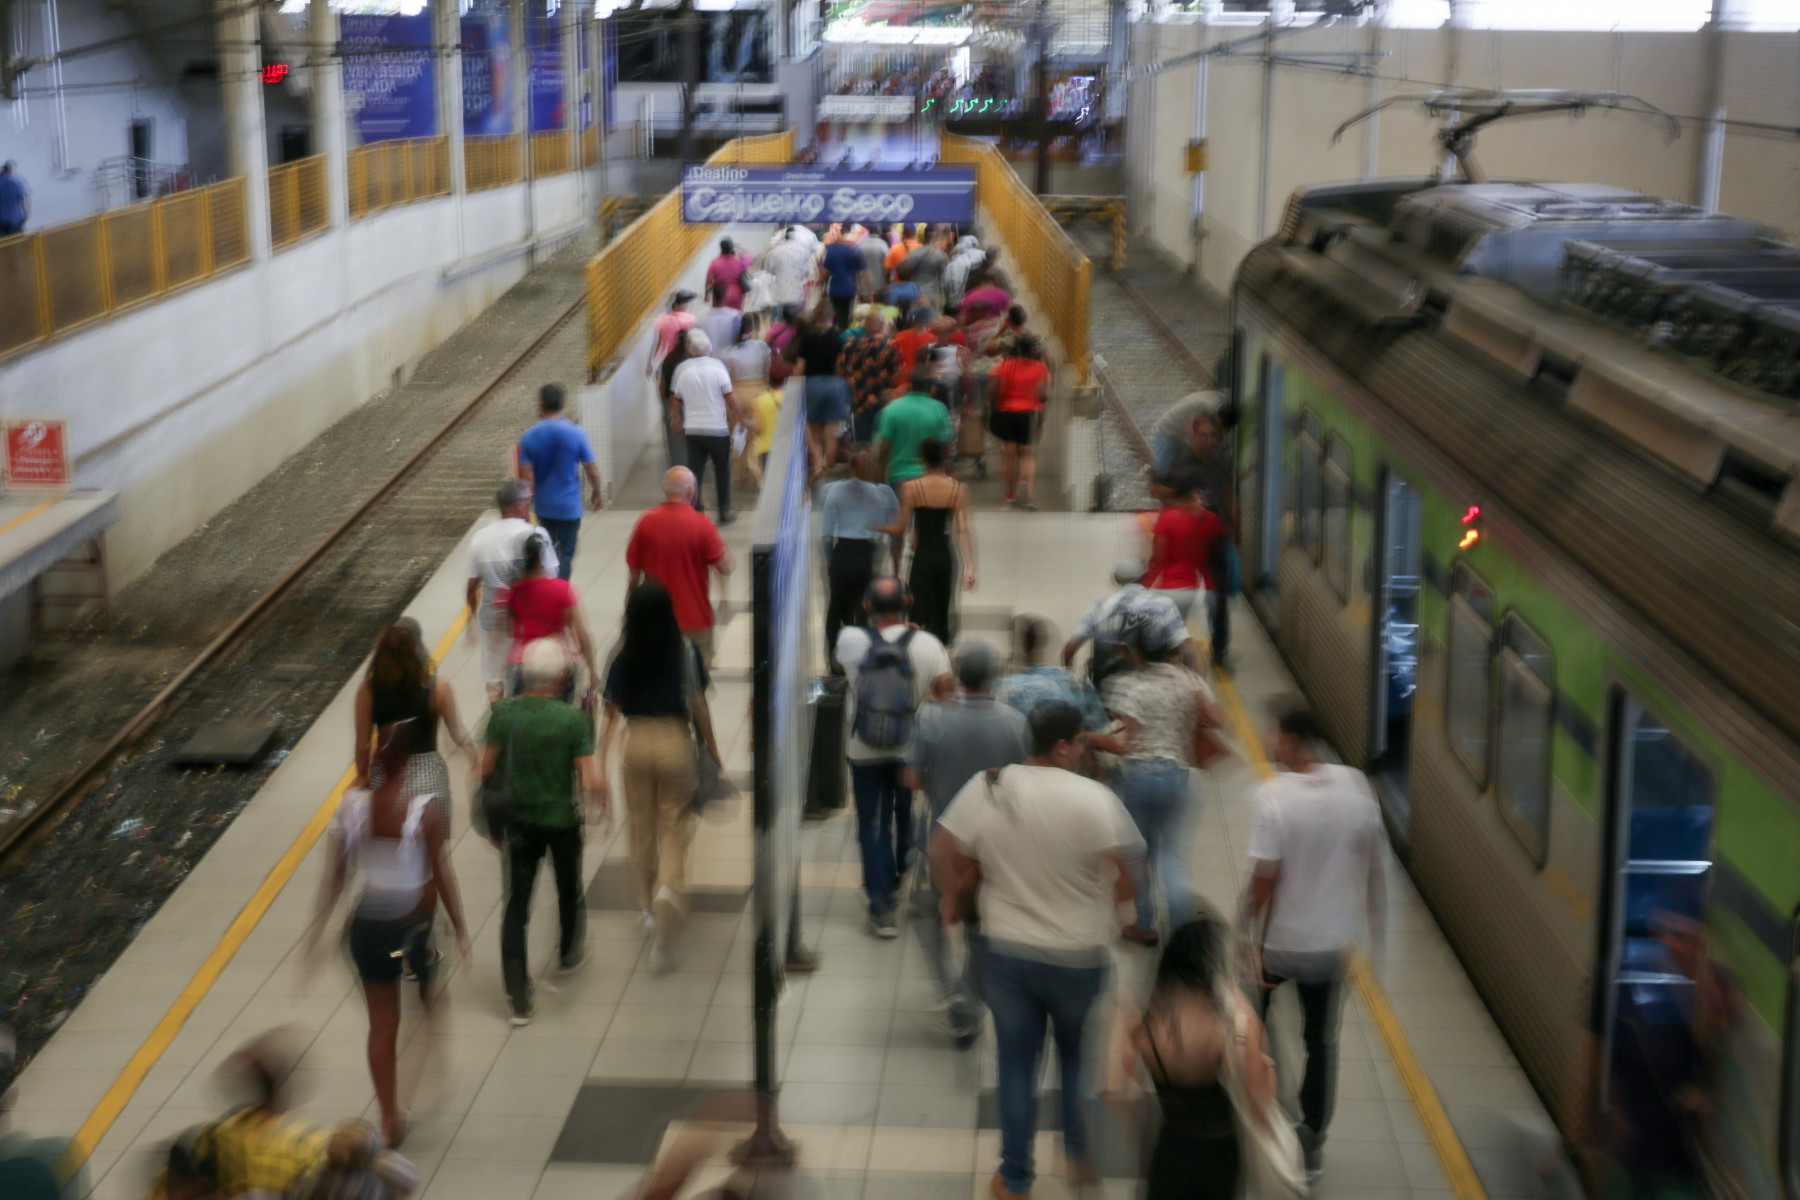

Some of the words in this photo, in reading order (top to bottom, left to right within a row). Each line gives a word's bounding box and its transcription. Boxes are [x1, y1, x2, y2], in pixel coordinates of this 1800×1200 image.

[691, 166, 749, 181] Destino
[688, 186, 825, 219] Cajueiro
[830, 186, 915, 218] Seco
